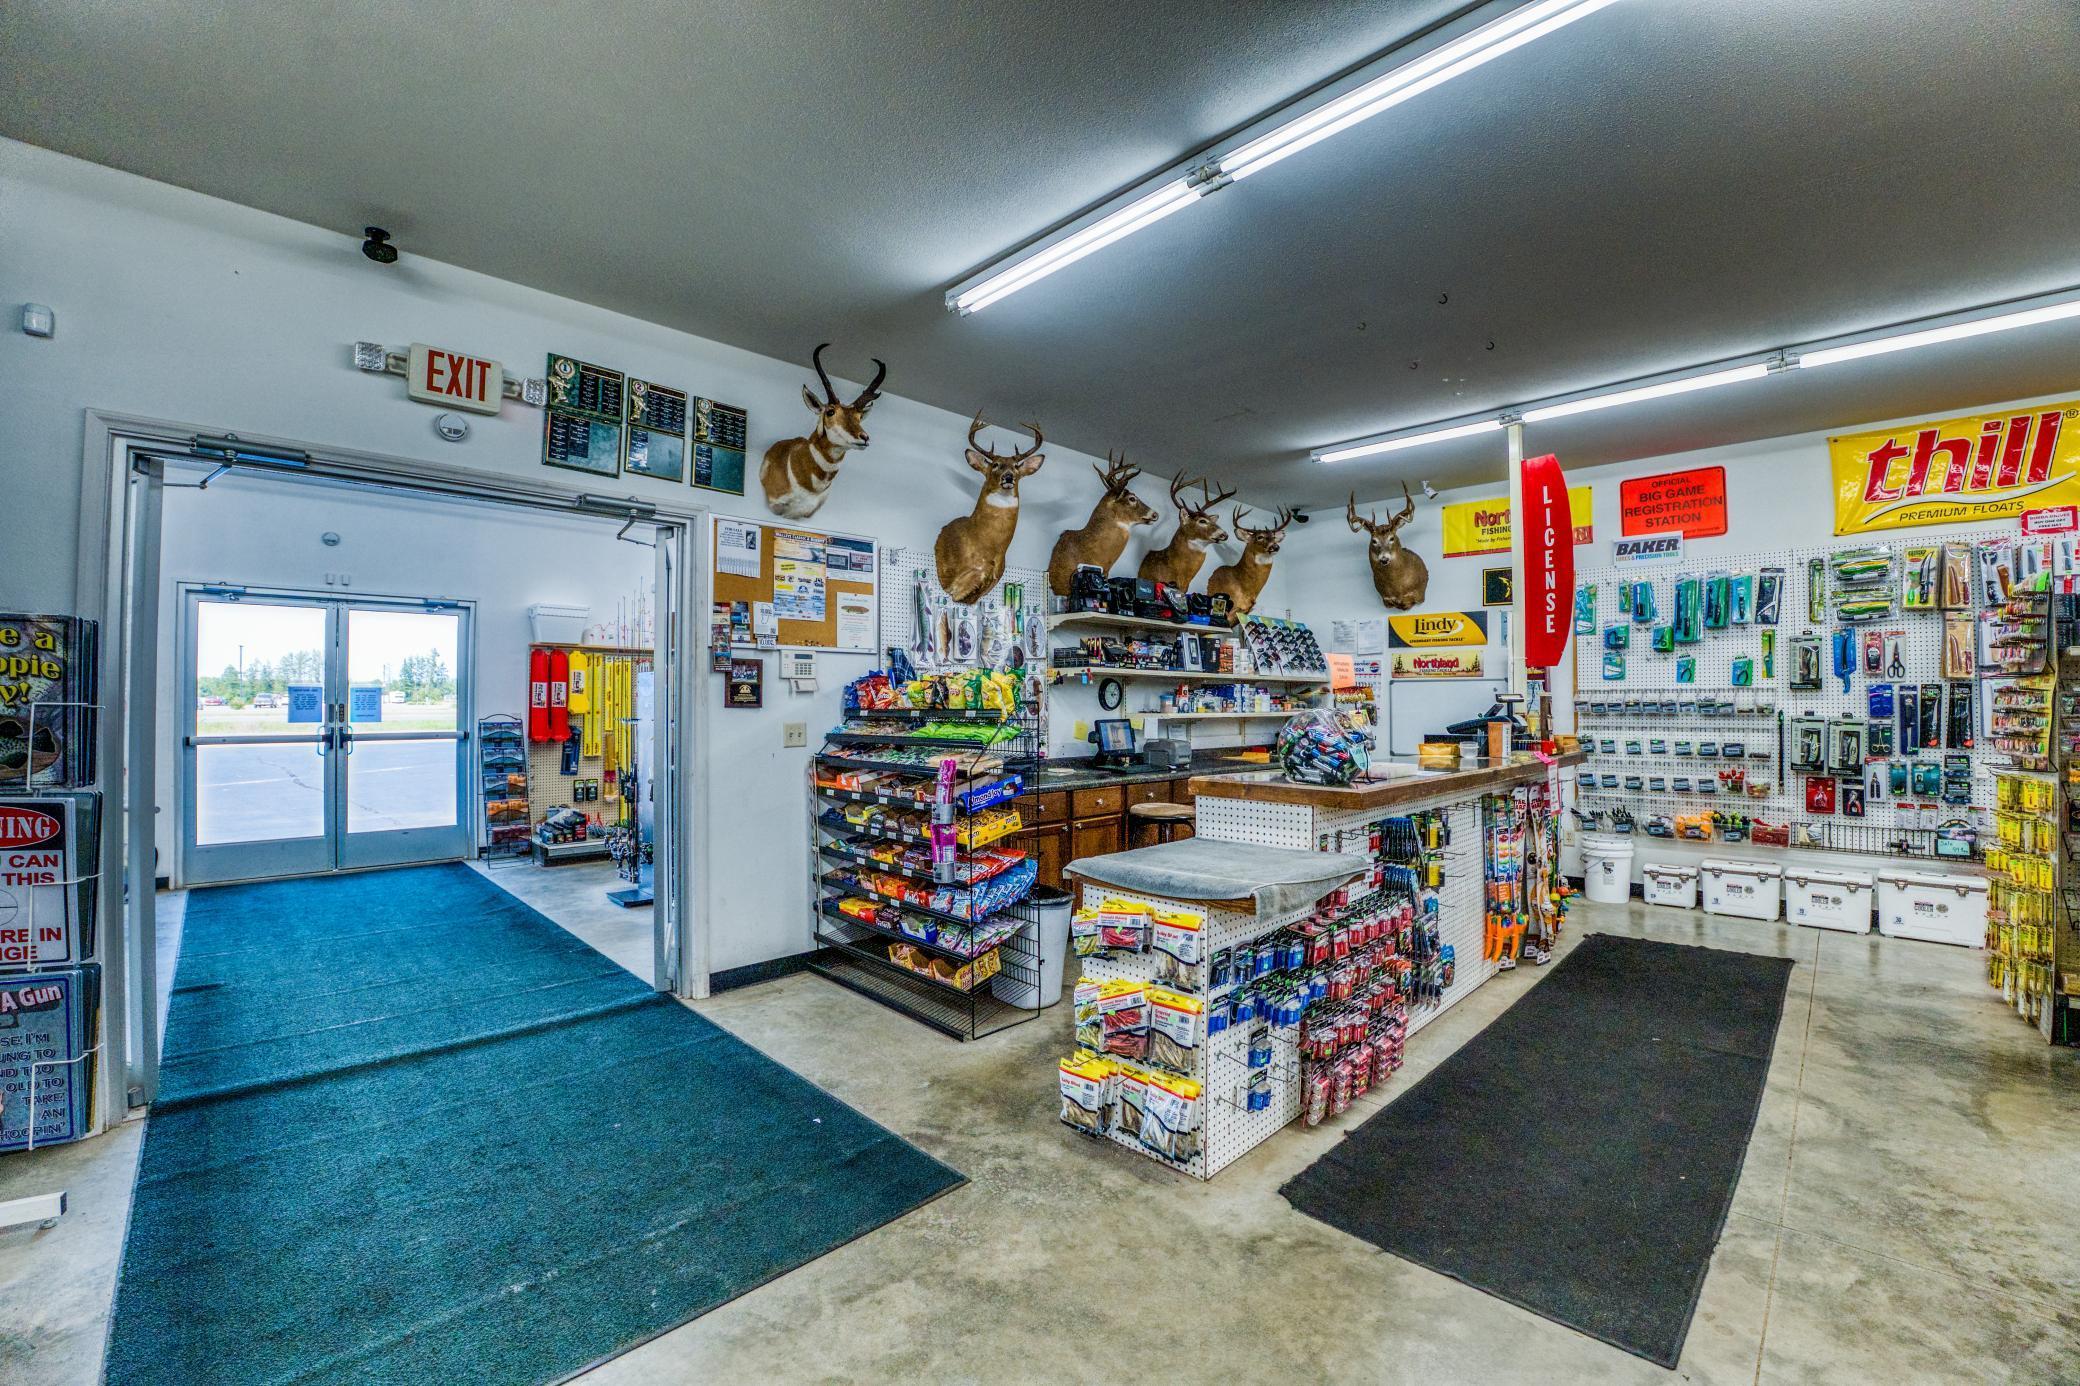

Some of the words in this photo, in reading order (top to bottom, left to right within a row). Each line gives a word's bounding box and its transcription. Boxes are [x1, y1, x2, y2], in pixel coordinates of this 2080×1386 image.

[426, 349, 491, 402] EXIT
[1864, 411, 2064, 503] thill
[1651, 478, 1691, 488] OFFICIAL
[1640, 491, 1662, 502] BIG
[1665, 485, 1705, 499] GAME
[1625, 496, 1723, 517] REGISTRATION
[1899, 506, 1967, 522] PREMIUM
[1973, 501, 2024, 515] FLOATS
[1645, 512, 1701, 528] STATION
[1616, 539, 1679, 555] BAKER
[1543, 486, 1556, 633] LICENSE
[1635, 552, 1662, 560] PRECISION
[1414, 618, 1457, 635] Lindy
[34, 632, 55, 650] a
[1413, 656, 1459, 670] Northland
[9, 854, 58, 868] CAN
[2, 872, 55, 886] THIS
[40, 927, 62, 942] IN
[18, 985, 62, 1007] Gun
[34, 1048, 56, 1060] TO
[42, 1077, 64, 1089] TO
[22, 1092, 65, 1106] TAKE
[41, 1107, 65, 1120] AN
